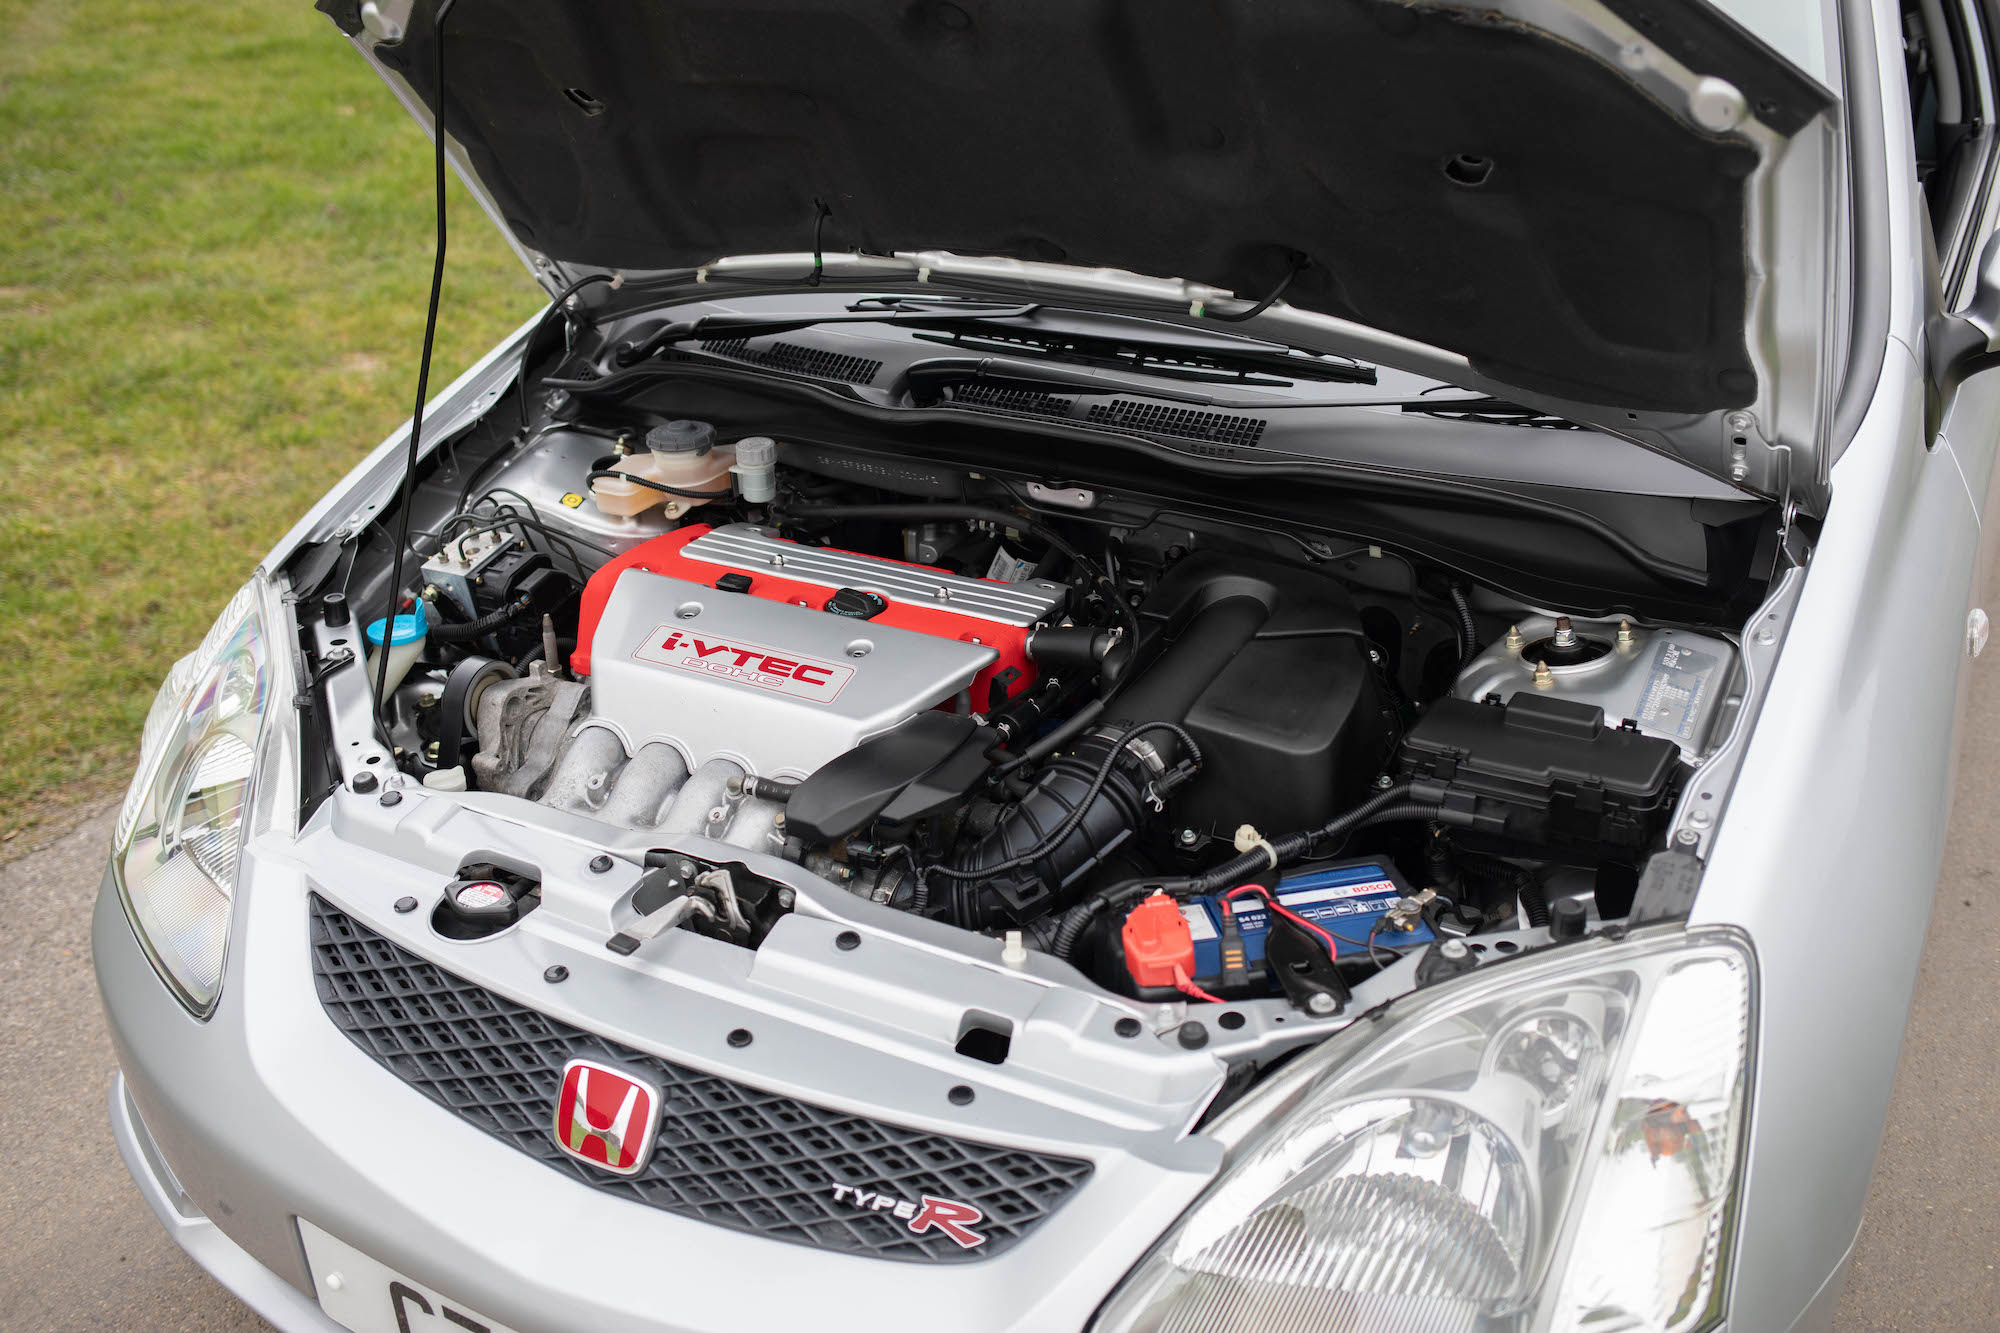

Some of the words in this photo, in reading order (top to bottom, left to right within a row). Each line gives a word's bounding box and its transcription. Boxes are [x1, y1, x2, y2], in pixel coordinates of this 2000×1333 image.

[661, 632, 834, 686] i-VTEC
[681, 656, 784, 688] DOHC
[1352, 882, 1393, 893] BOSCH
[832, 1182, 918, 1220] TYPE
[907, 1194, 987, 1249] R
